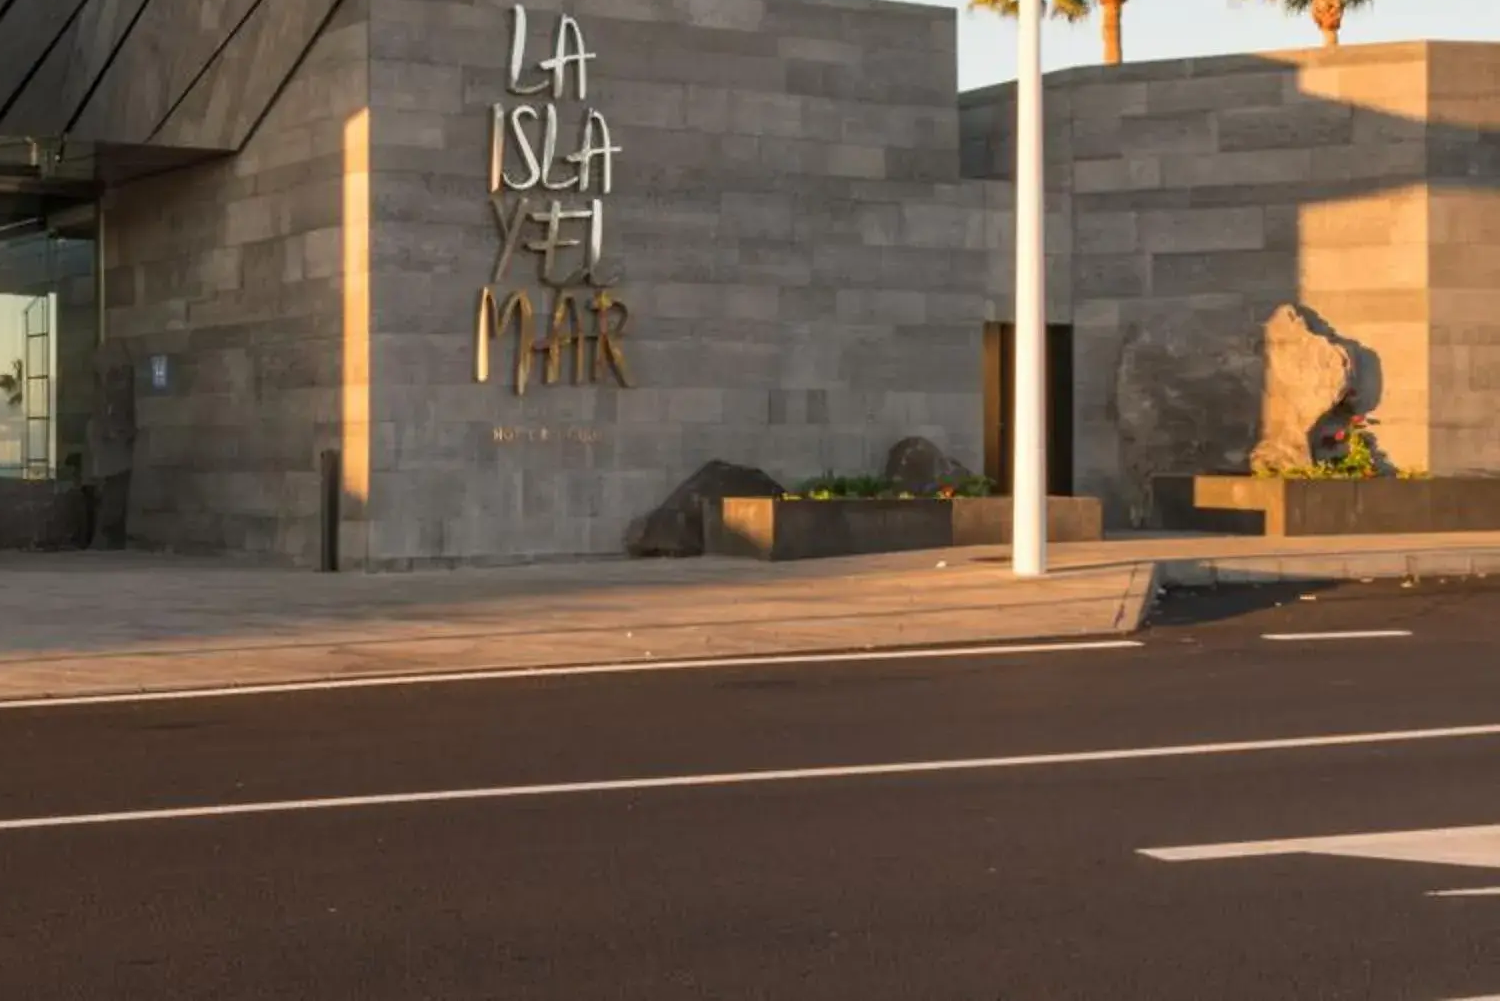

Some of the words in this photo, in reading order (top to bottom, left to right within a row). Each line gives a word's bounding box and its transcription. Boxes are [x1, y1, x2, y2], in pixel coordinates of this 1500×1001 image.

[509, 3, 596, 99] LA
[488, 102, 622, 193] ISLA
[475, 286, 636, 396] MAR
